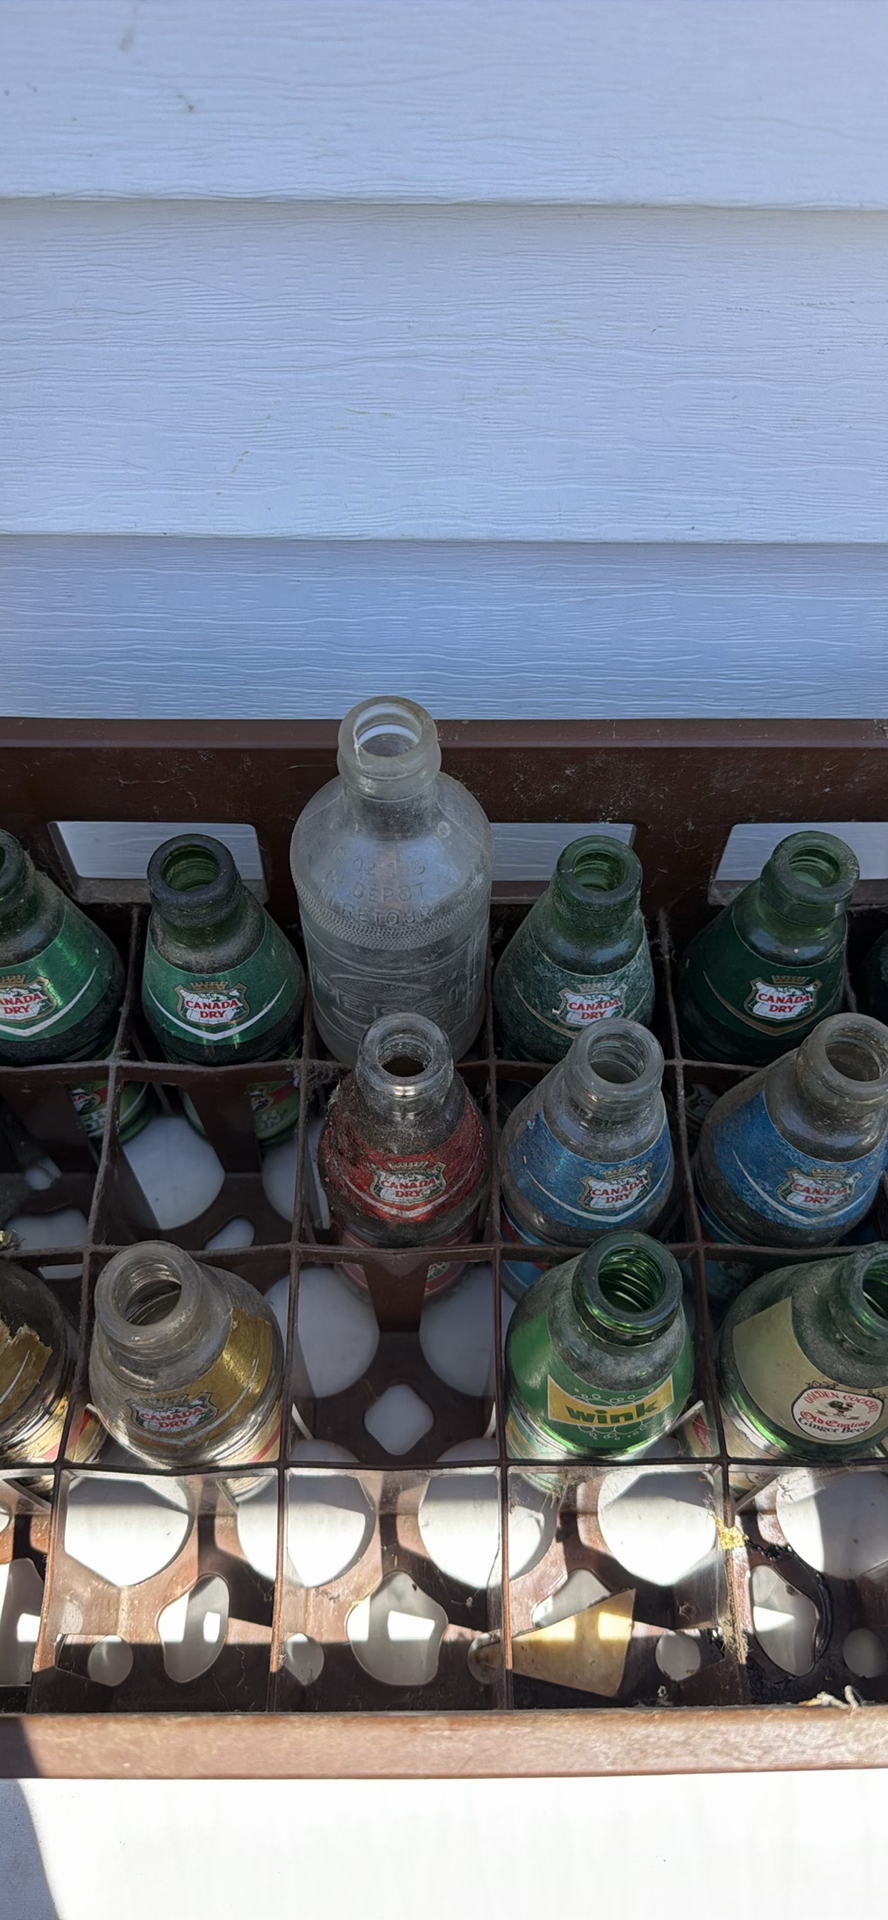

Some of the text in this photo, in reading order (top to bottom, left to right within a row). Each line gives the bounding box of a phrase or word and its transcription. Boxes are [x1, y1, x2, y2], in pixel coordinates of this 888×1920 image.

[185, 999, 239, 1010] CANADA
[568, 998, 620, 1011] CANADA
[758, 993, 810, 1004] CANADA
[3, 1005, 30, 1014] DRY
[199, 1010, 226, 1018] DRY
[769, 1005, 796, 1013] DRY
[581, 1011, 607, 1020] DRY
[380, 1177, 436, 1189] CANADA
[591, 1177, 645, 1196] CANADA
[792, 1183, 849, 1195] CANADA
[395, 1189, 423, 1198] DRY
[606, 1192, 631, 1204] DRY
[803, 1195, 830, 1204] DRY
[803, 1389, 840, 1405] GOLDEN
[140, 1407, 203, 1421] CANADA
[565, 1400, 658, 1424] wink
[158, 1419, 189, 1428] DRY
[797, 1417, 869, 1434] Ginger Beer
[800, 1410, 871, 1429] Old English
